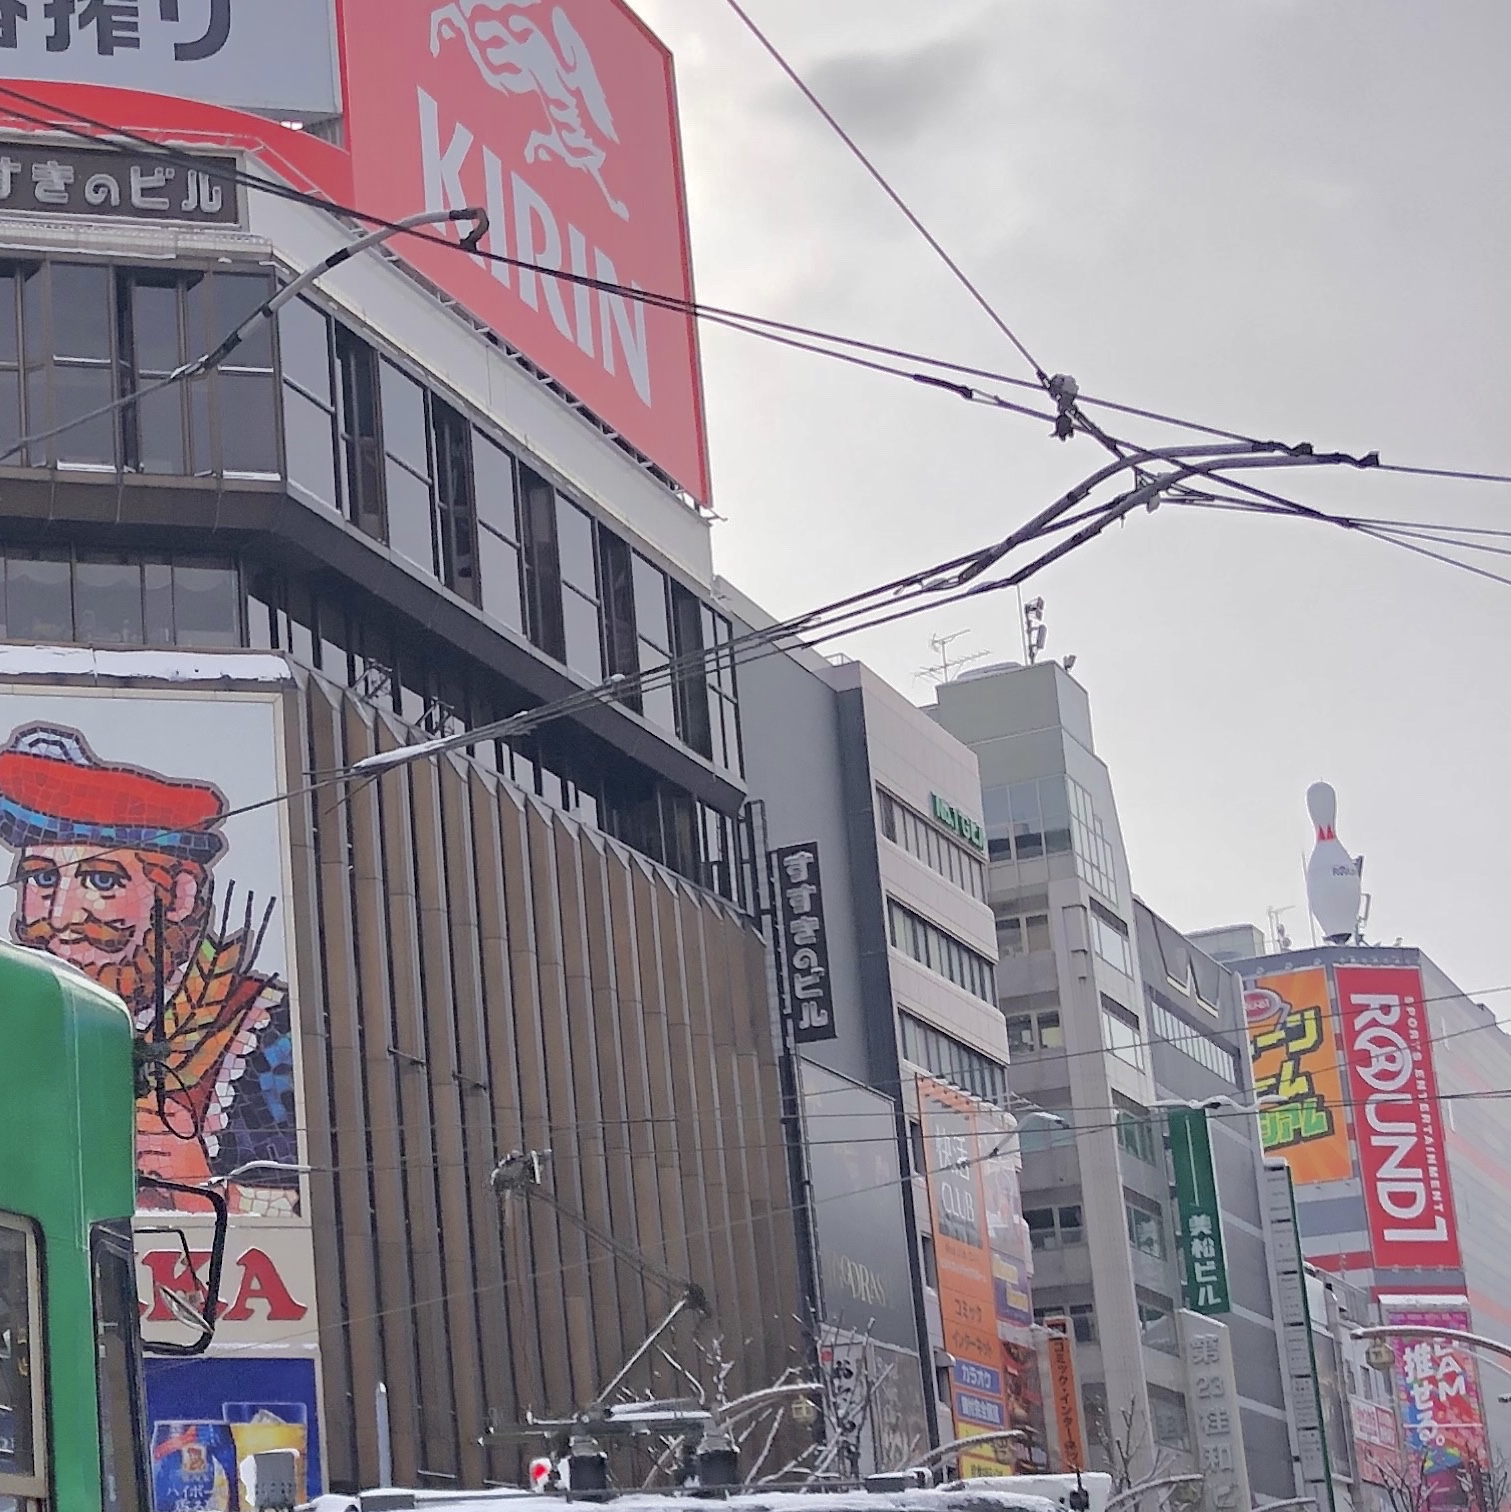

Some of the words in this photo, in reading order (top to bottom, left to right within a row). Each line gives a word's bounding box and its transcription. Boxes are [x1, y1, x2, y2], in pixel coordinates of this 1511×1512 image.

[417, 86, 651, 408] KIRIN
[783, 851, 829, 1029] すすきのビル
[1350, 993, 1449, 1242] ROUND1
[941, 1182, 975, 1222] CLUB
[138, 1248, 307, 1320] KA
[1054, 1341, 1080, 1472] コミック・インターネッ
